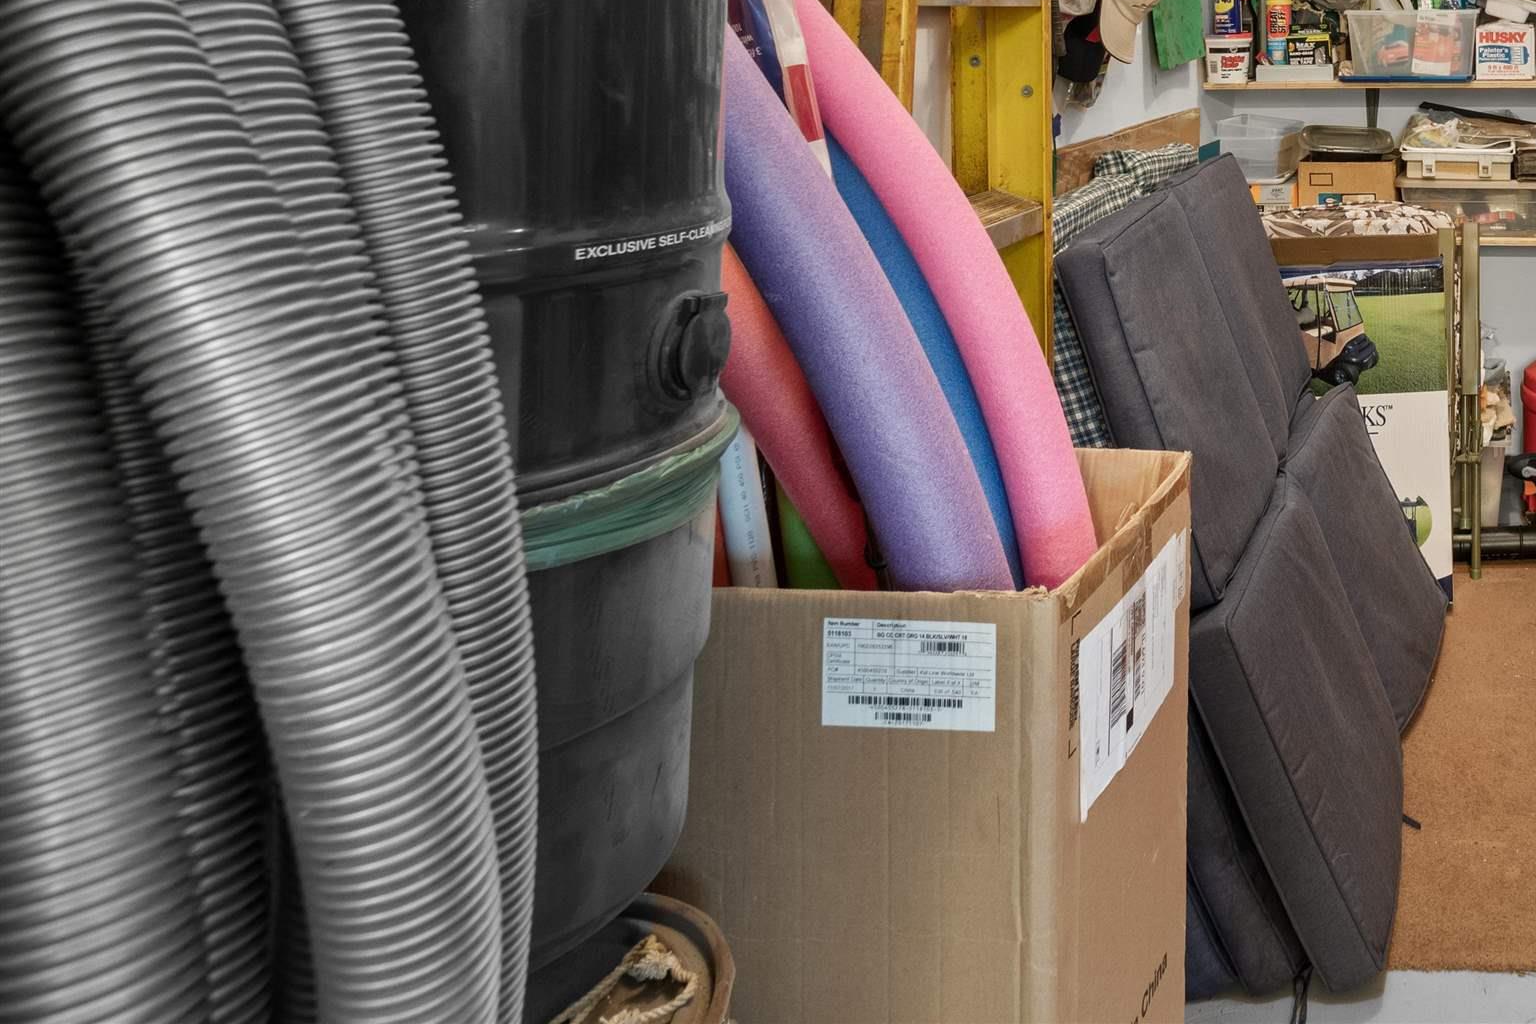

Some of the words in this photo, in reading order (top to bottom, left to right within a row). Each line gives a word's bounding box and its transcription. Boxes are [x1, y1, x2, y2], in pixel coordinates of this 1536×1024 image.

[1479, 32, 1527, 43] HUSKY
[575, 238, 657, 260] EXCLUSIVE
[1141, 952, 1168, 1018] China
